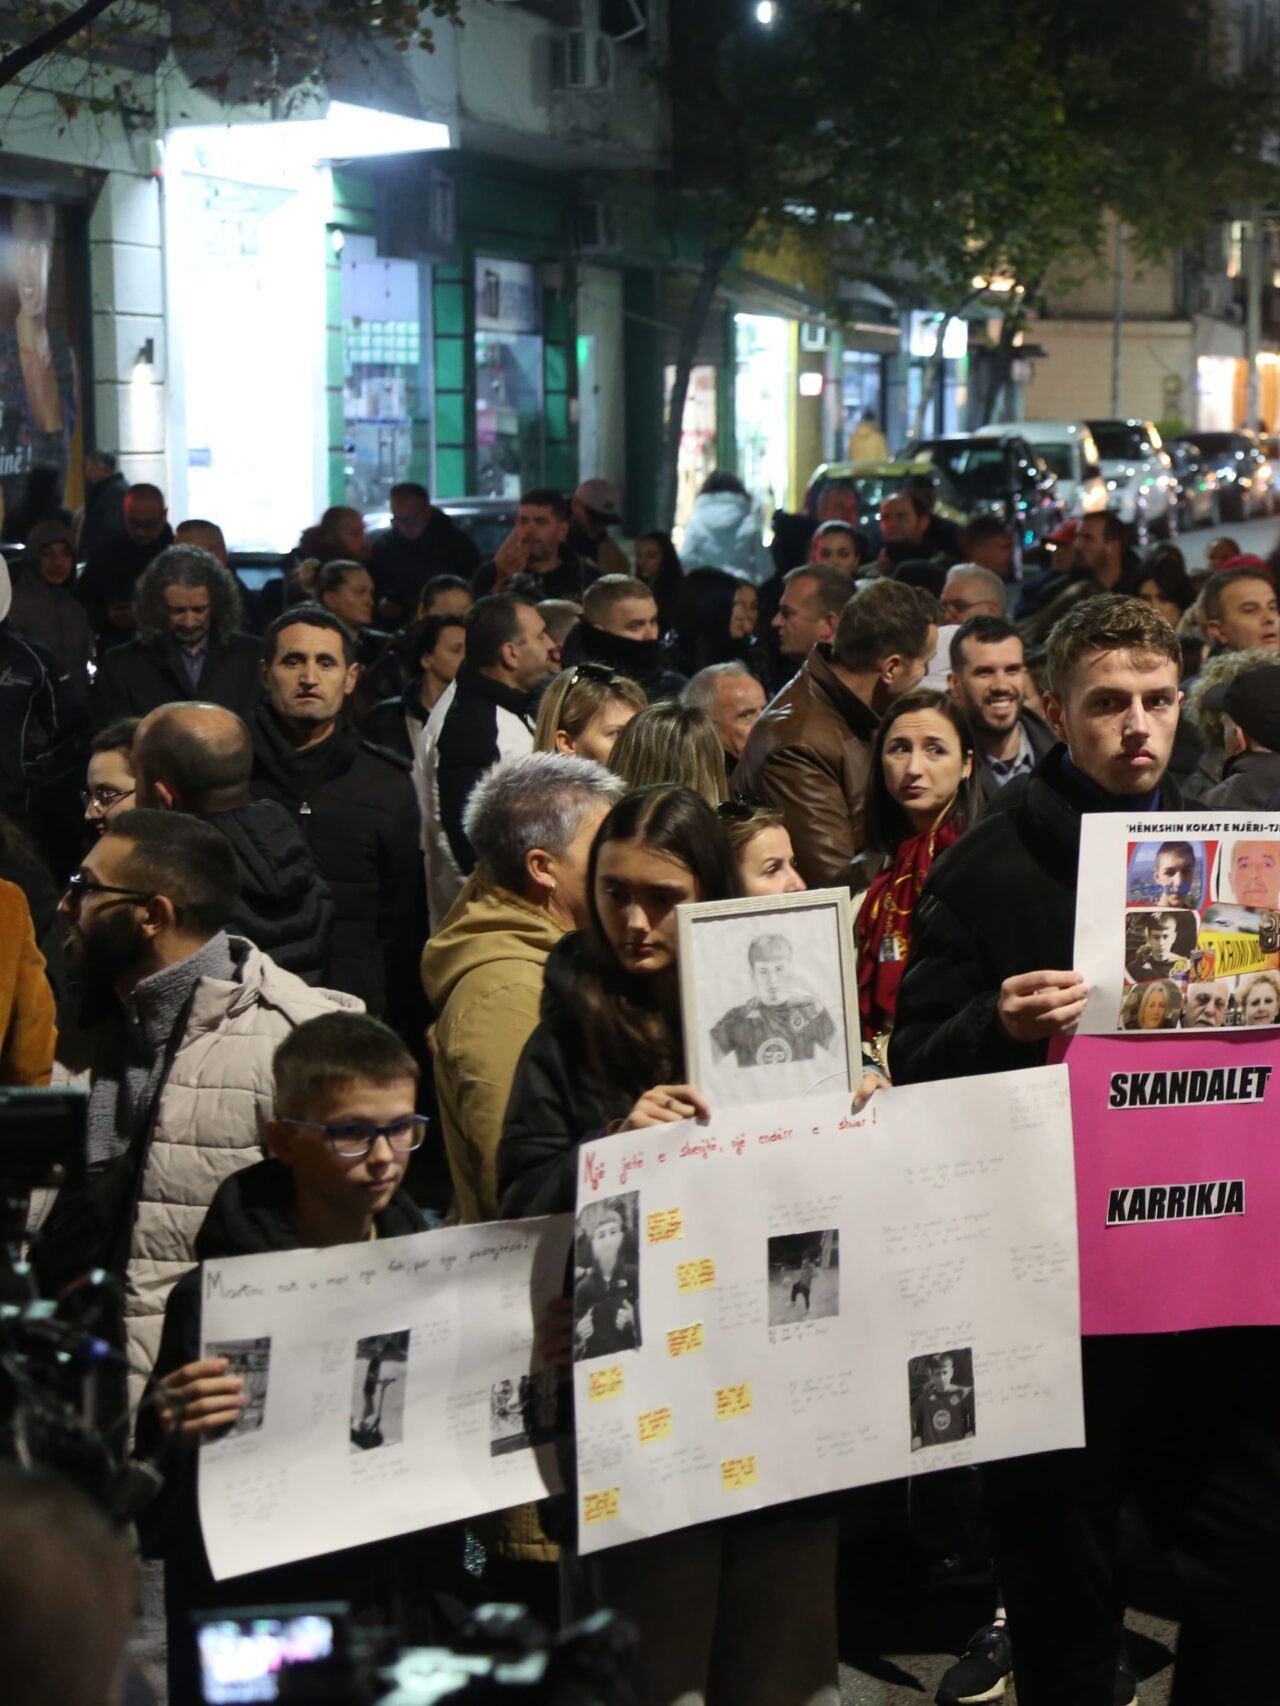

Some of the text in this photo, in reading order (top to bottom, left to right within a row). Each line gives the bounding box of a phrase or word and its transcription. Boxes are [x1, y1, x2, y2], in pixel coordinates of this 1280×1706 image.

[1186, 822, 1222, 833] KOKAT
[1224, 823, 1230, 833] E
[1109, 1067, 1272, 1108] SKANDALET
[657, 1153, 666, 1163] e
[811, 1125, 820, 1135] e
[1107, 1181, 1244, 1223] KARRIKJA
